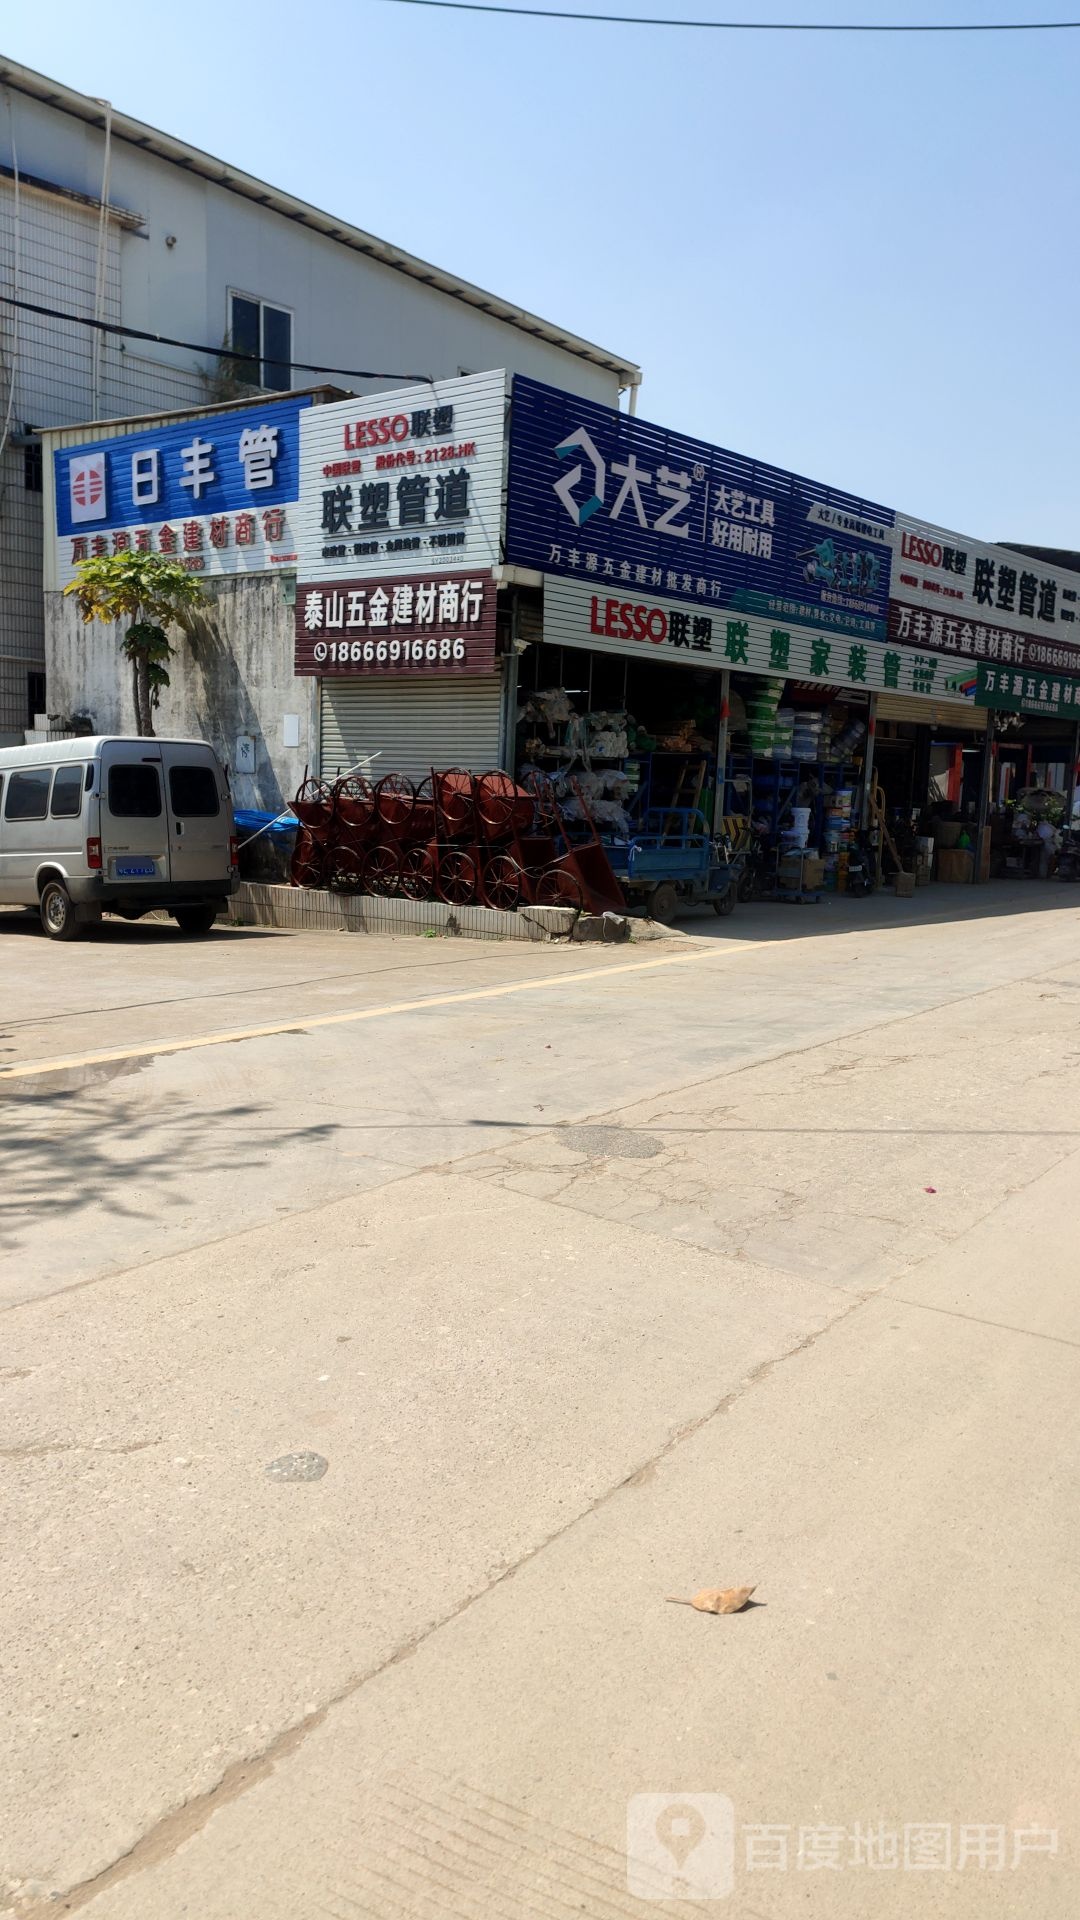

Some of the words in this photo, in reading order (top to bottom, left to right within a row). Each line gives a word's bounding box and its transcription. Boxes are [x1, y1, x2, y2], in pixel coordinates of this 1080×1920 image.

[343, 413, 409, 451] LESSO
[410, 405, 454, 438] 联塑
[131, 424, 280, 506] 日丰管
[321, 467, 470, 534] 联塑管道
[608, 453, 692, 539] 大艺
[713, 484, 776, 528] 大艺工具
[70, 508, 286, 565] 万丰源五金建材商行
[711, 517, 773, 560] 好用耐用
[901, 531, 943, 568] LESSO
[942, 546, 968, 576] 联塑
[549, 543, 722, 597] 万丰源五金建材批发商行
[972, 557, 1058, 622] 联塑管道
[304, 579, 483, 630] 泰山五金建材商行
[590, 595, 668, 645] LESSO
[668, 610, 713, 652] 联塑
[330, 637, 466, 662] 18666916686
[724, 620, 902, 690] 联塑家装管
[897, 606, 1026, 663] 万丰源五金建材商行
